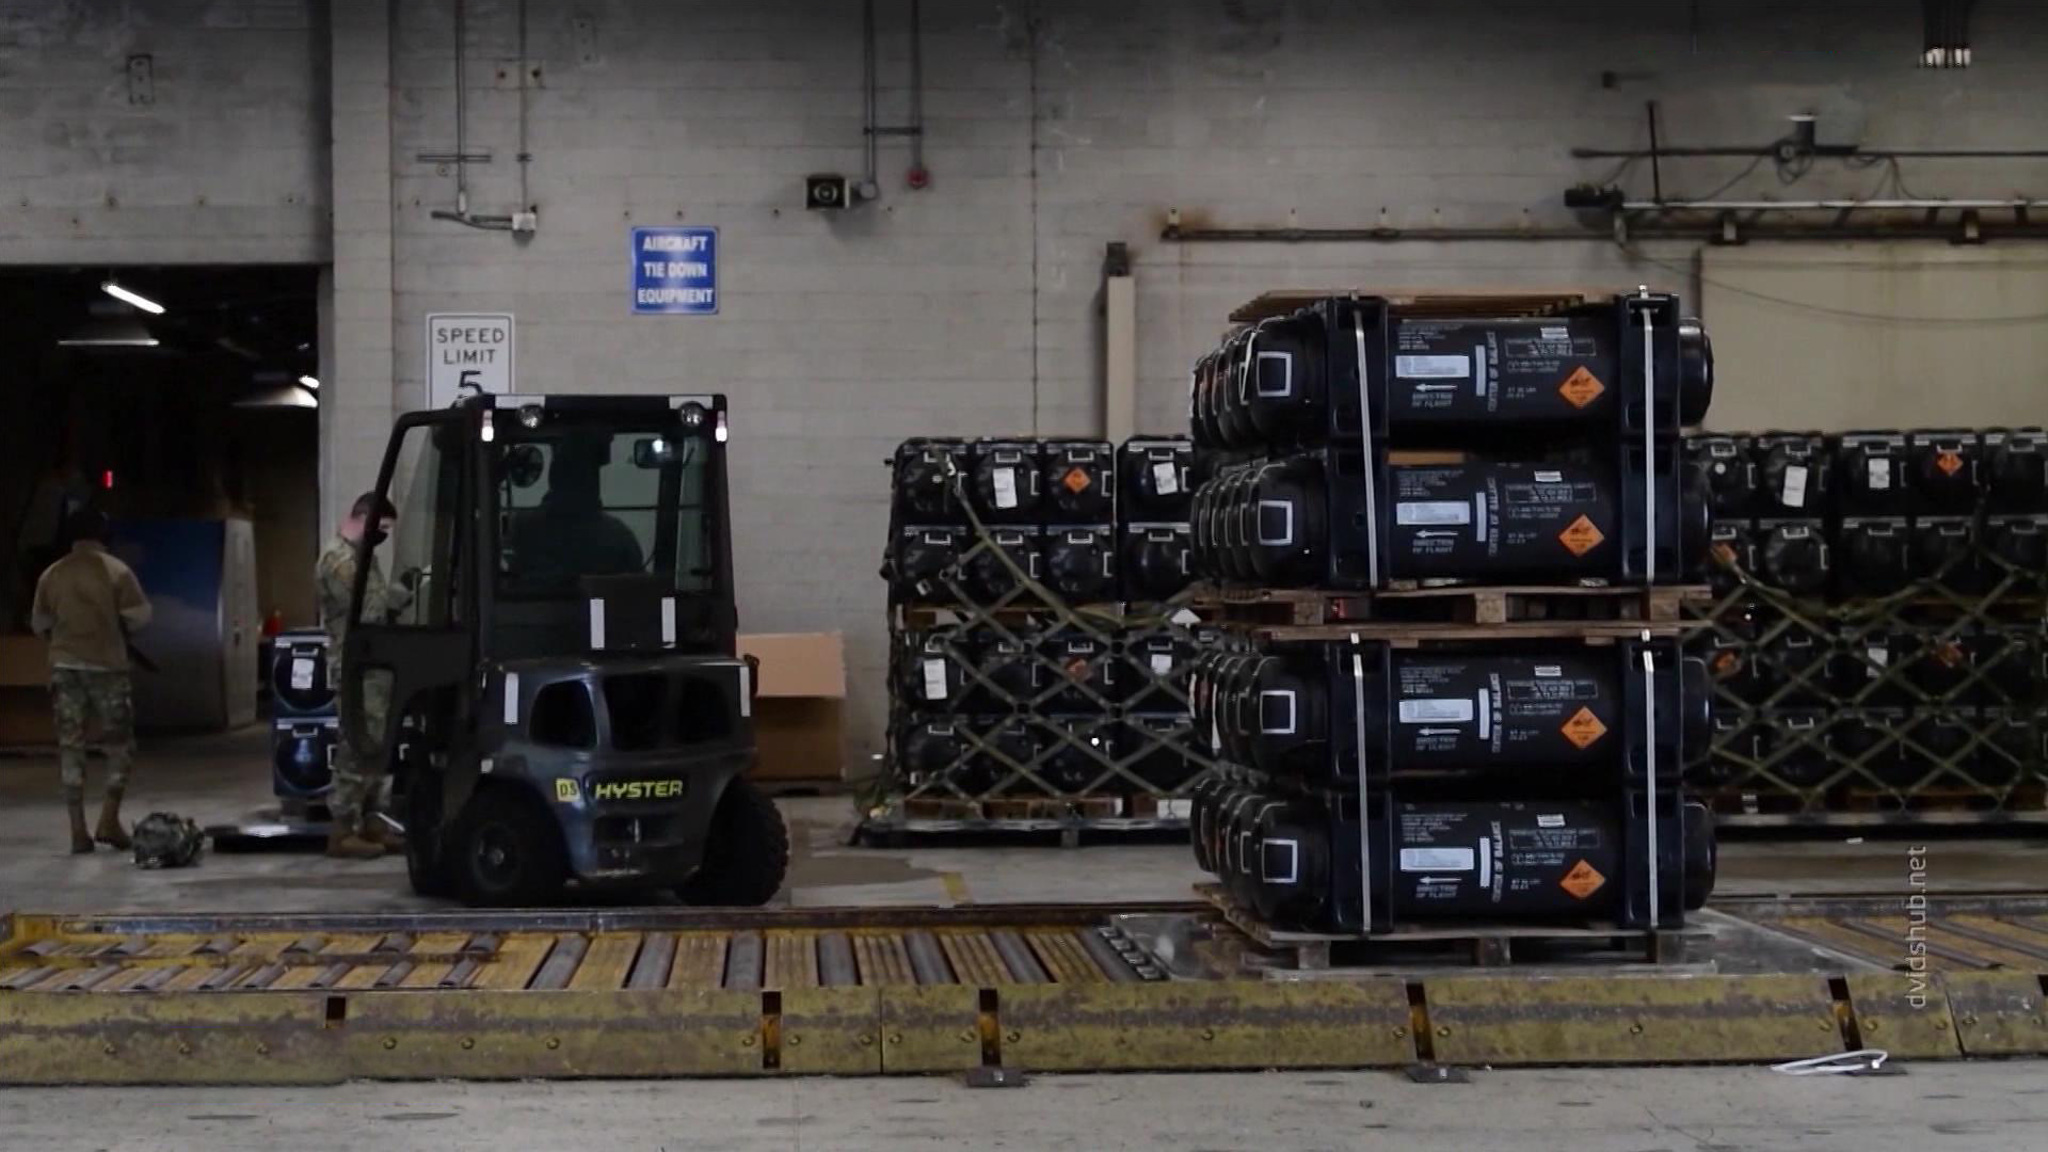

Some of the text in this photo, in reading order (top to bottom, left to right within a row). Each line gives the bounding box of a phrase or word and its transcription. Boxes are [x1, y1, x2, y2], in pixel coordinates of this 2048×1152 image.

[643, 236, 708, 252] AIRCRAFT
[643, 262, 708, 278] TIE DOWN
[637, 288, 713, 304] EQUIPMENT
[436, 328, 504, 344] SPEED
[443, 349, 496, 365] LIMIT
[458, 370, 483, 398] 5
[594, 779, 684, 800] HYSTER
